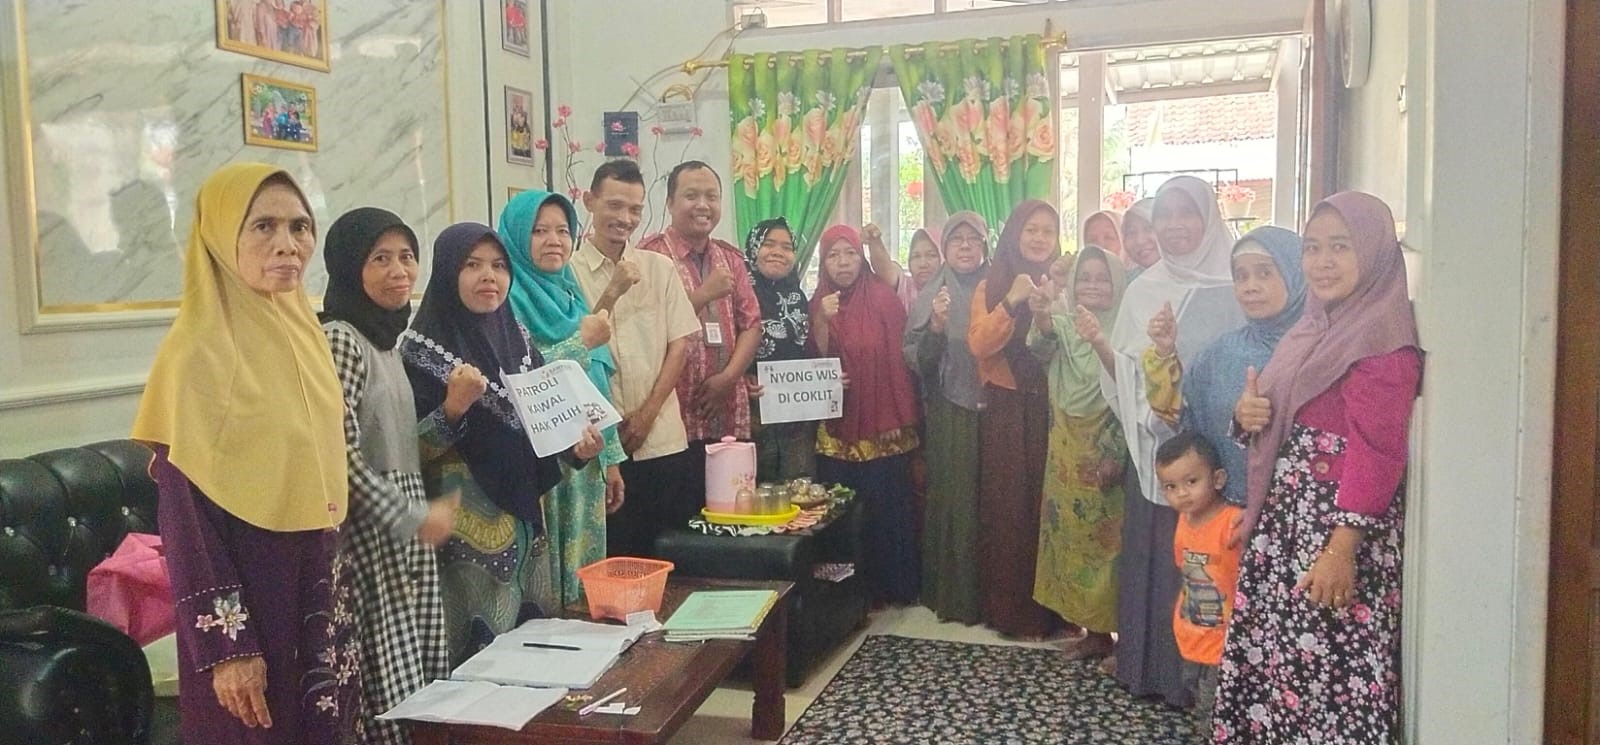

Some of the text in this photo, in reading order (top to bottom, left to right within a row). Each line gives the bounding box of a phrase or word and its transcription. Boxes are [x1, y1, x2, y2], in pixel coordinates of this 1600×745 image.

[770, 369, 838, 384] NYONG WIS
[516, 377, 559, 398] PATROLI
[778, 390, 833, 404] DI COKLIT
[527, 394, 566, 416] KAWAL
[531, 405, 582, 434] HAK PILIH
